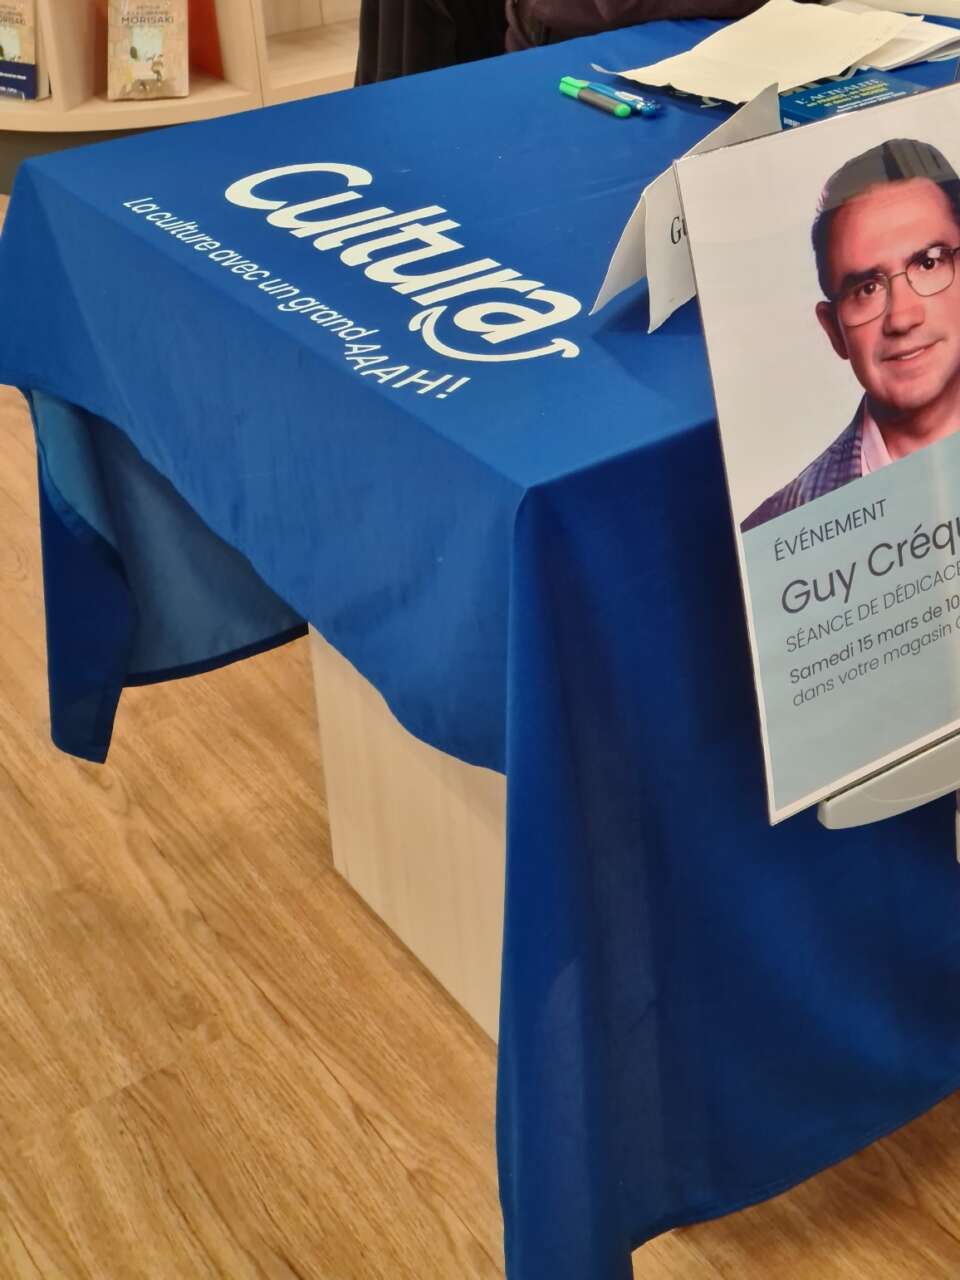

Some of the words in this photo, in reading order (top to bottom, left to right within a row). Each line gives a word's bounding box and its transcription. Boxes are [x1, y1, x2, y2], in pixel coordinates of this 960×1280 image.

[123, 197, 160, 214] La
[146, 212, 221, 251] culture
[208, 249, 270, 281] avec
[225, 162, 583, 363] Cultura
[258, 278, 300, 299] un
[278, 297, 380, 341] grand
[344, 343, 471, 399] AAAH!
[774, 499, 887, 562] ÉVÉNEMENT
[781, 562, 857, 614] Guy
[786, 610, 855, 652] SÉANCE
[857, 598, 879, 621] DE
[790, 642, 855, 684] Samedi
[858, 634, 874, 652] 15
[877, 616, 919, 645] mars
[922, 605, 943, 623] de
[793, 677, 835, 706] dans
[838, 657, 880, 685] votre
[883, 623, 952, 666] magasin
